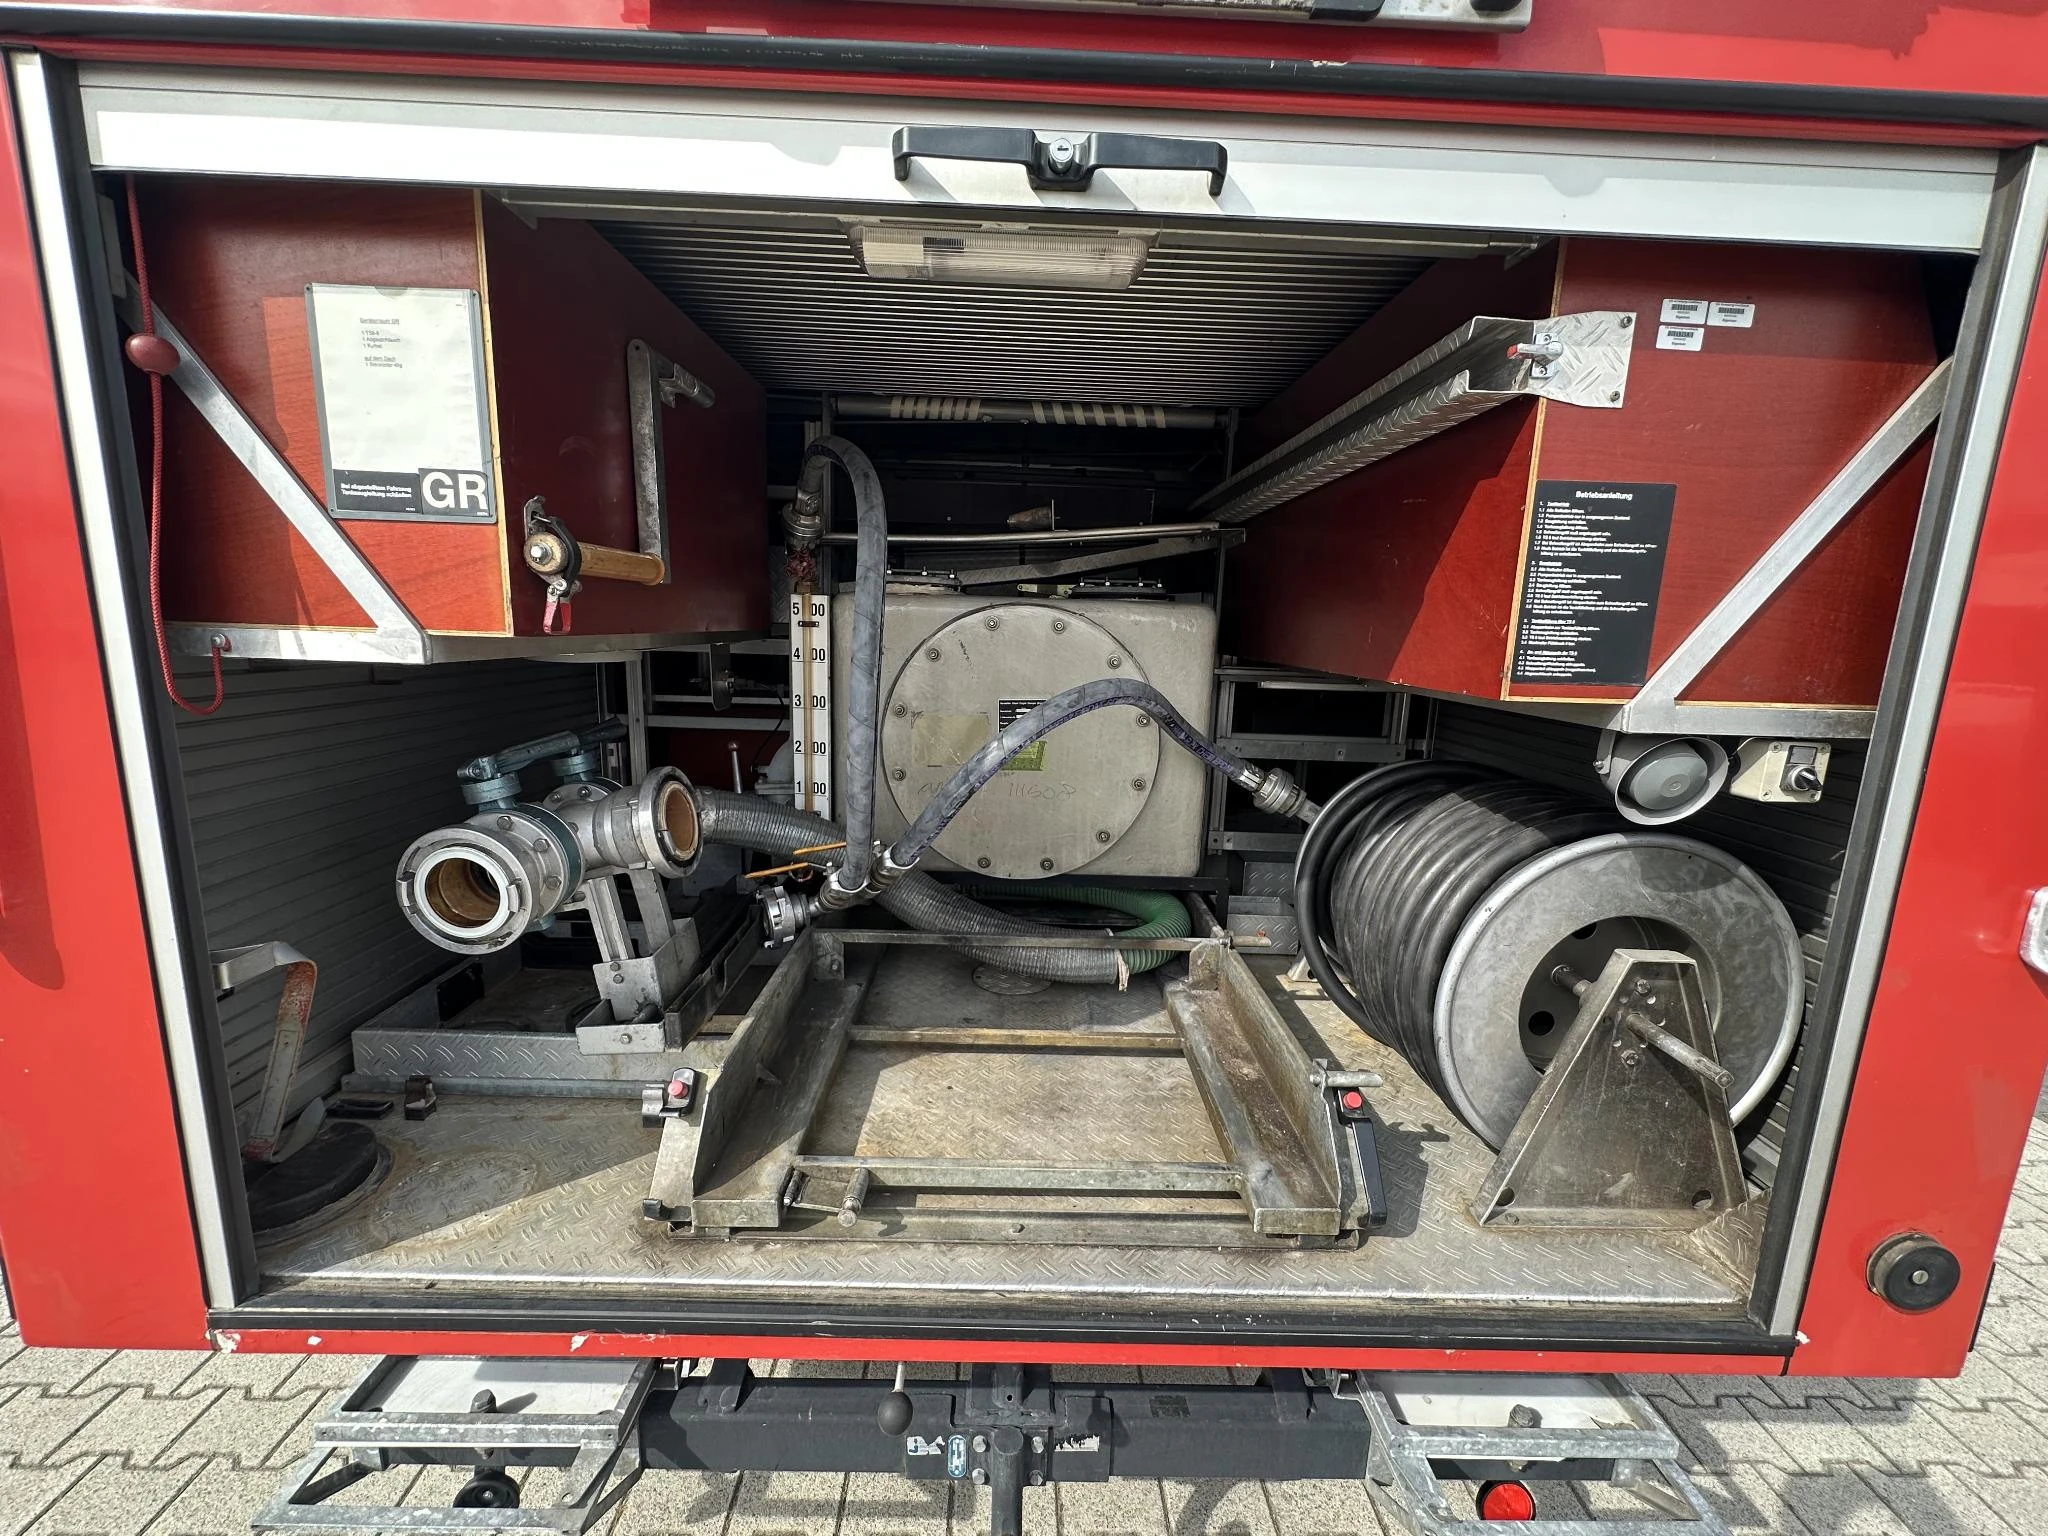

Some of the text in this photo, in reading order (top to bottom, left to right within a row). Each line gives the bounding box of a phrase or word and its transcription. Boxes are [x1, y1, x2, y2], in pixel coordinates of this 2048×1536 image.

[422, 471, 489, 510] GR
[1575, 490, 1633, 501] Betriebsanleitung
[792, 602, 800, 616] 5
[793, 647, 801, 660] 4
[794, 694, 802, 707] 3
[794, 740, 802, 753] 2
[796, 780, 802, 793] 1
